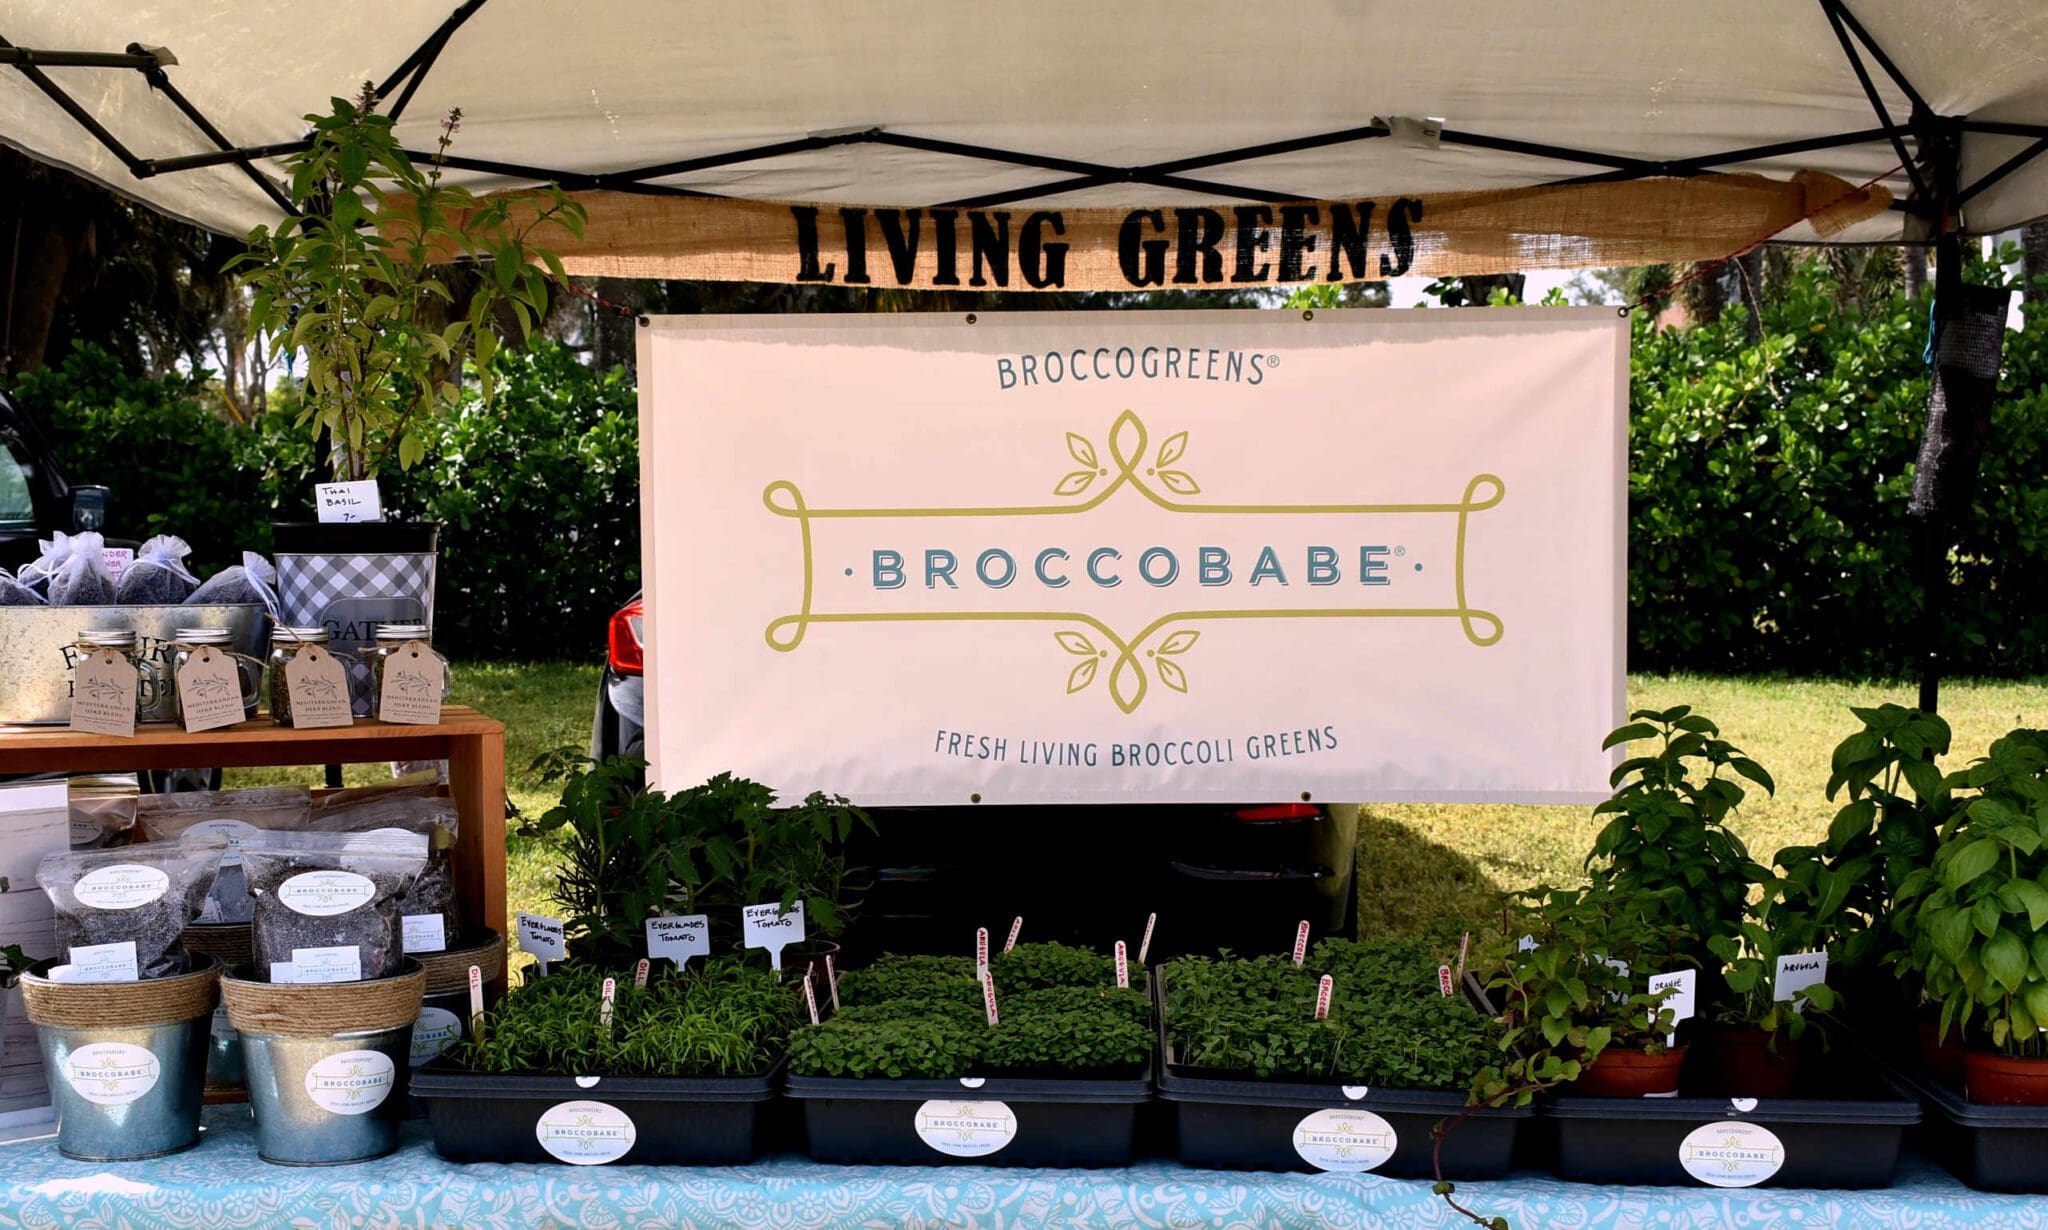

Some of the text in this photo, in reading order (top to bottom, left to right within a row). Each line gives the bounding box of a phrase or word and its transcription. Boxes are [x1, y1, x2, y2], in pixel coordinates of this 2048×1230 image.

[791, 198, 1423, 288] LIVING GREENS
[325, 498, 362, 507] BASIL
[935, 725, 1339, 767] FRESH LIVING BROCCOLI GREENS
[752, 918, 792, 929] TOMATO
[658, 933, 696, 942] TOMATO
[471, 968, 479, 990] DILL
[80, 1069, 141, 1078] BROCCOBABE
[323, 1077, 383, 1087] BROCCOBABE
[934, 1120, 998, 1128] BROCCOBABE
[554, 1129, 617, 1137] BROCCOBABE
[1312, 1135, 1378, 1145] BROCCOBABE
[1699, 1150, 1765, 1159] BROCCOBABE
